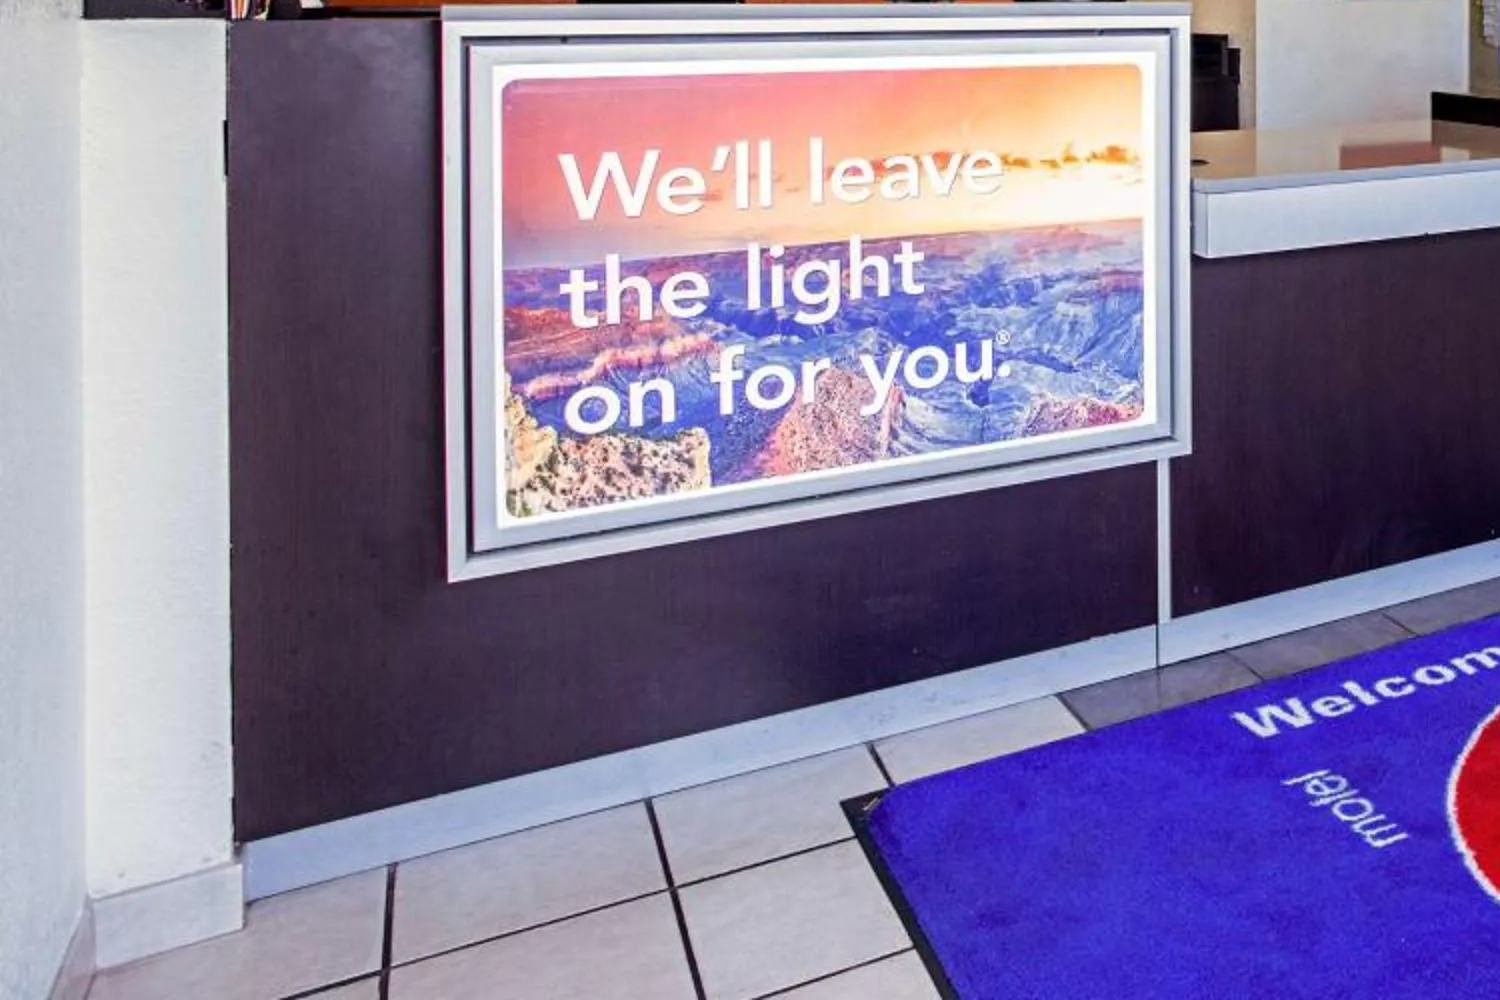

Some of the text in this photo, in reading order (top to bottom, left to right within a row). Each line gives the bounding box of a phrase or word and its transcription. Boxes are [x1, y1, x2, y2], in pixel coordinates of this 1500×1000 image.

[557, 135, 1005, 222] We’ll leave
[559, 233, 926, 330] the light
[563, 374, 676, 435] on
[710, 344, 832, 417] for
[1280, 768, 1409, 848] motel
